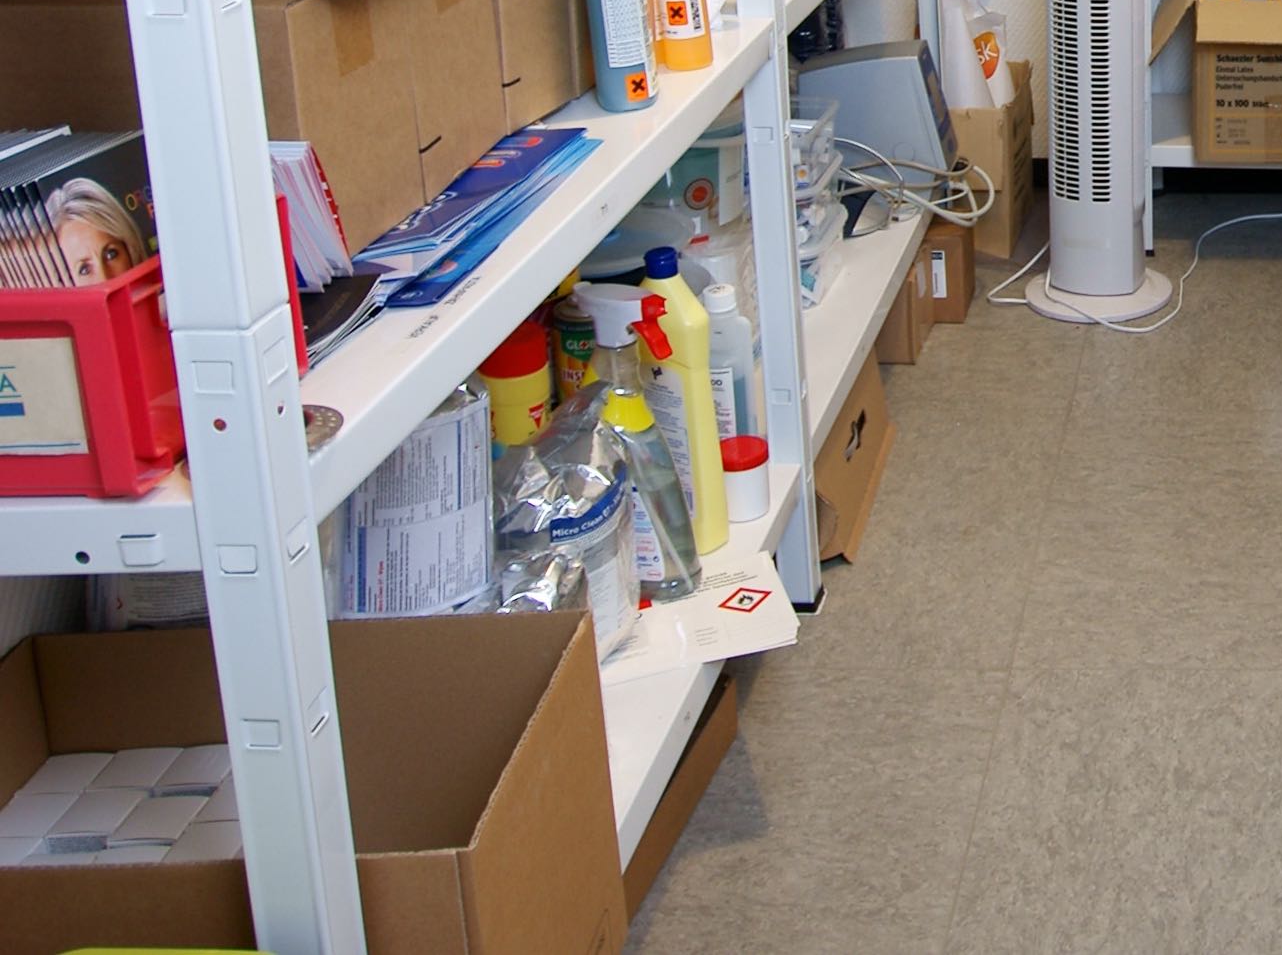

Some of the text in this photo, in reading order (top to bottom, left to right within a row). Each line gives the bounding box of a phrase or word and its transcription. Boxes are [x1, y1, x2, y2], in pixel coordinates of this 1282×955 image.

[1237, 65, 1254, 73] Latex
[1216, 99, 1226, 108] 10
[1234, 99, 1249, 108] 100
[552, 527, 580, 538] Micro
[581, 514, 604, 531] Clean
